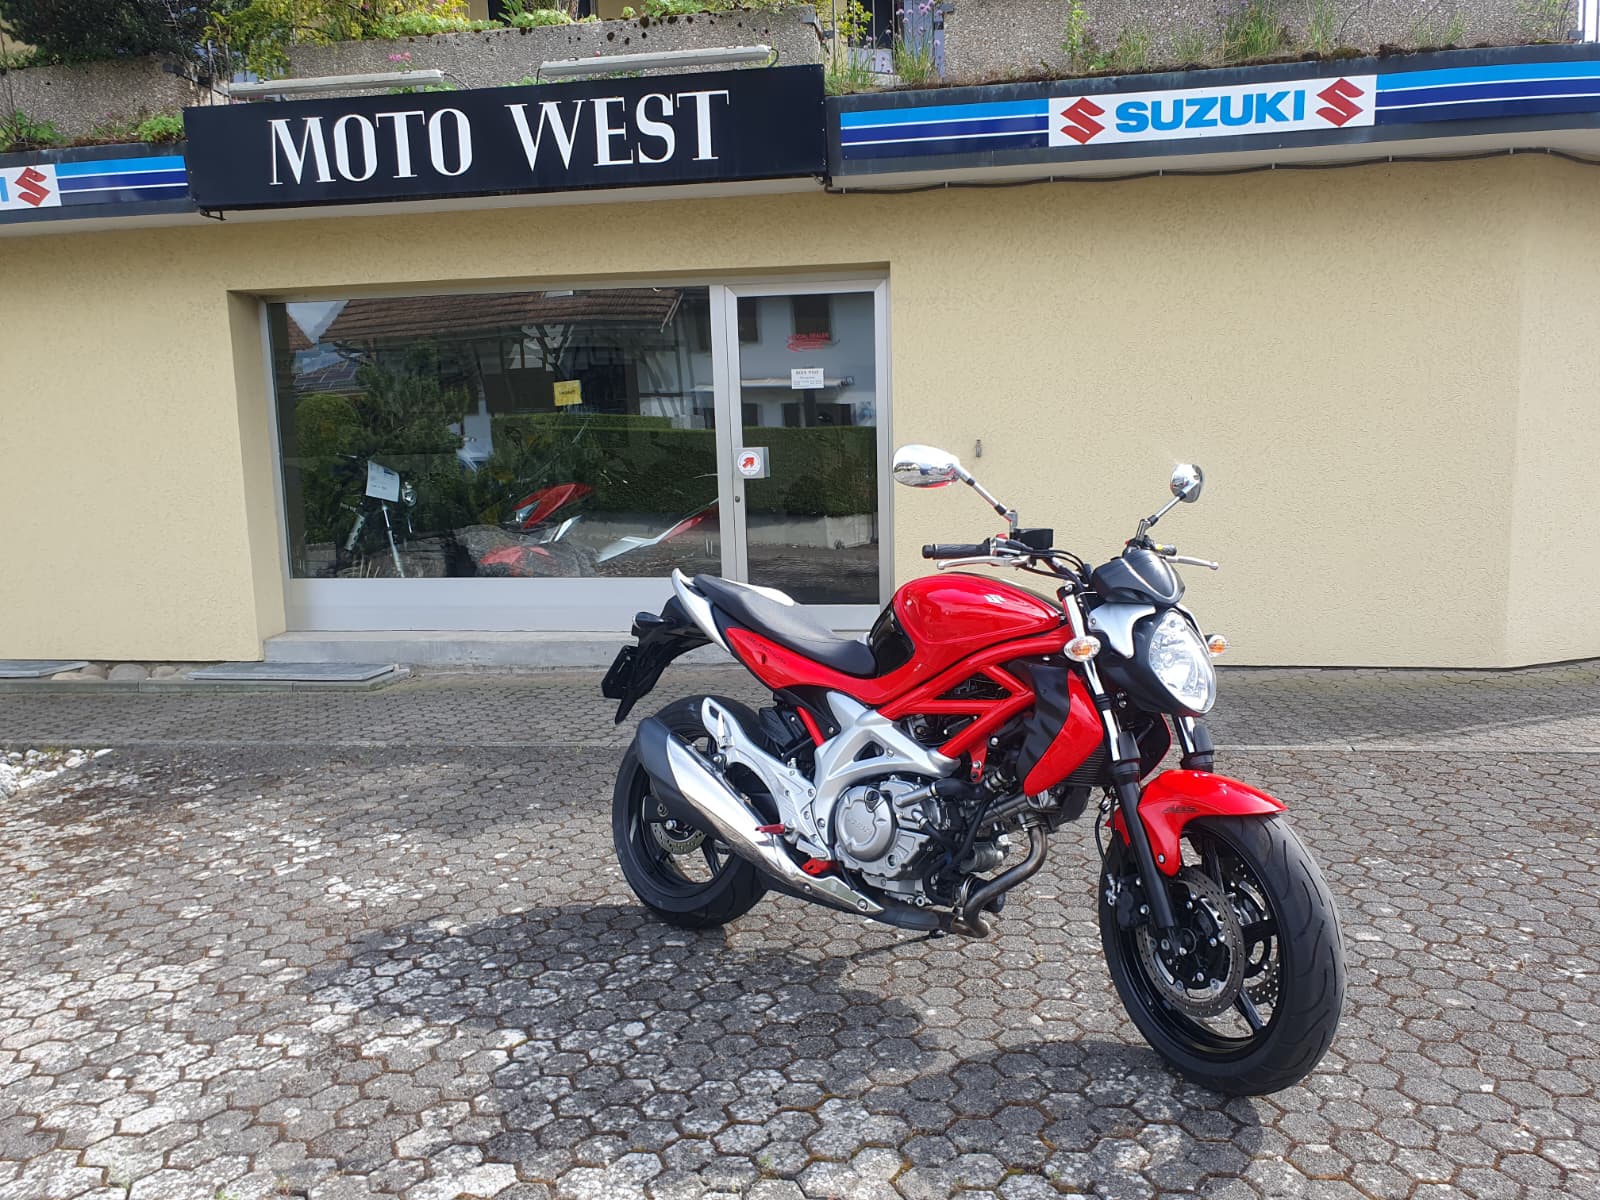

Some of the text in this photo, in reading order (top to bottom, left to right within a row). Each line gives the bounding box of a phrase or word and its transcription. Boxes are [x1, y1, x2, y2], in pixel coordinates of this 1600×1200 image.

[268, 90, 730, 186] MOTO WEST
[1116, 90, 1306, 133] SUZUKI
